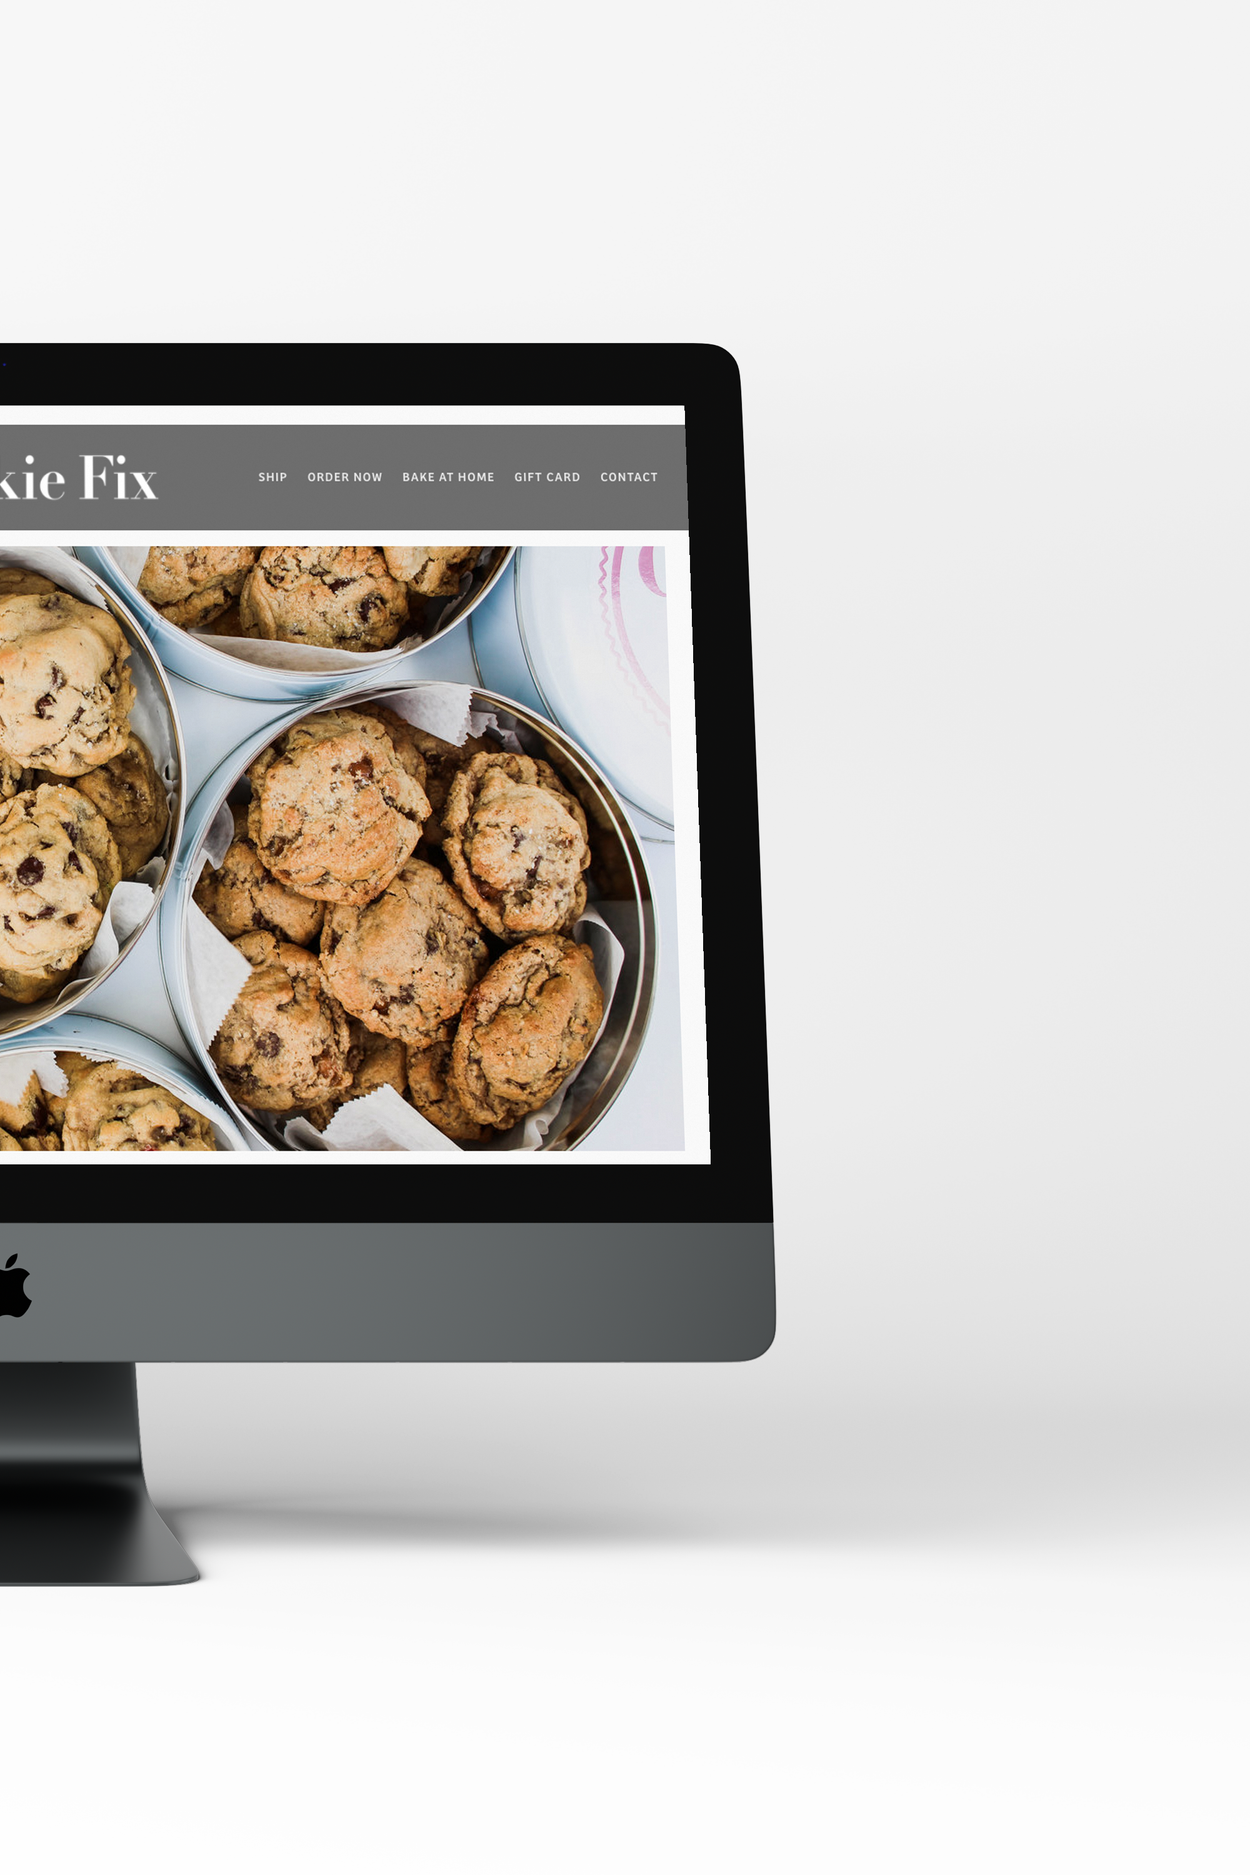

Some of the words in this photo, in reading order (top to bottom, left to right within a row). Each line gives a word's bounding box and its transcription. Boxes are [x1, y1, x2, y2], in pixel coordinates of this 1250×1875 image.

[78, 454, 160, 501] Fix
[258, 471, 288, 482] SHIP
[307, 471, 350, 482] ORDER
[353, 471, 383, 482] NOW
[402, 471, 435, 482] BAKE
[438, 471, 454, 482] AT
[457, 471, 495, 482] HOME
[514, 471, 543, 482] GIFT
[546, 471, 581, 482] CARD
[600, 471, 658, 482] CONTACT
